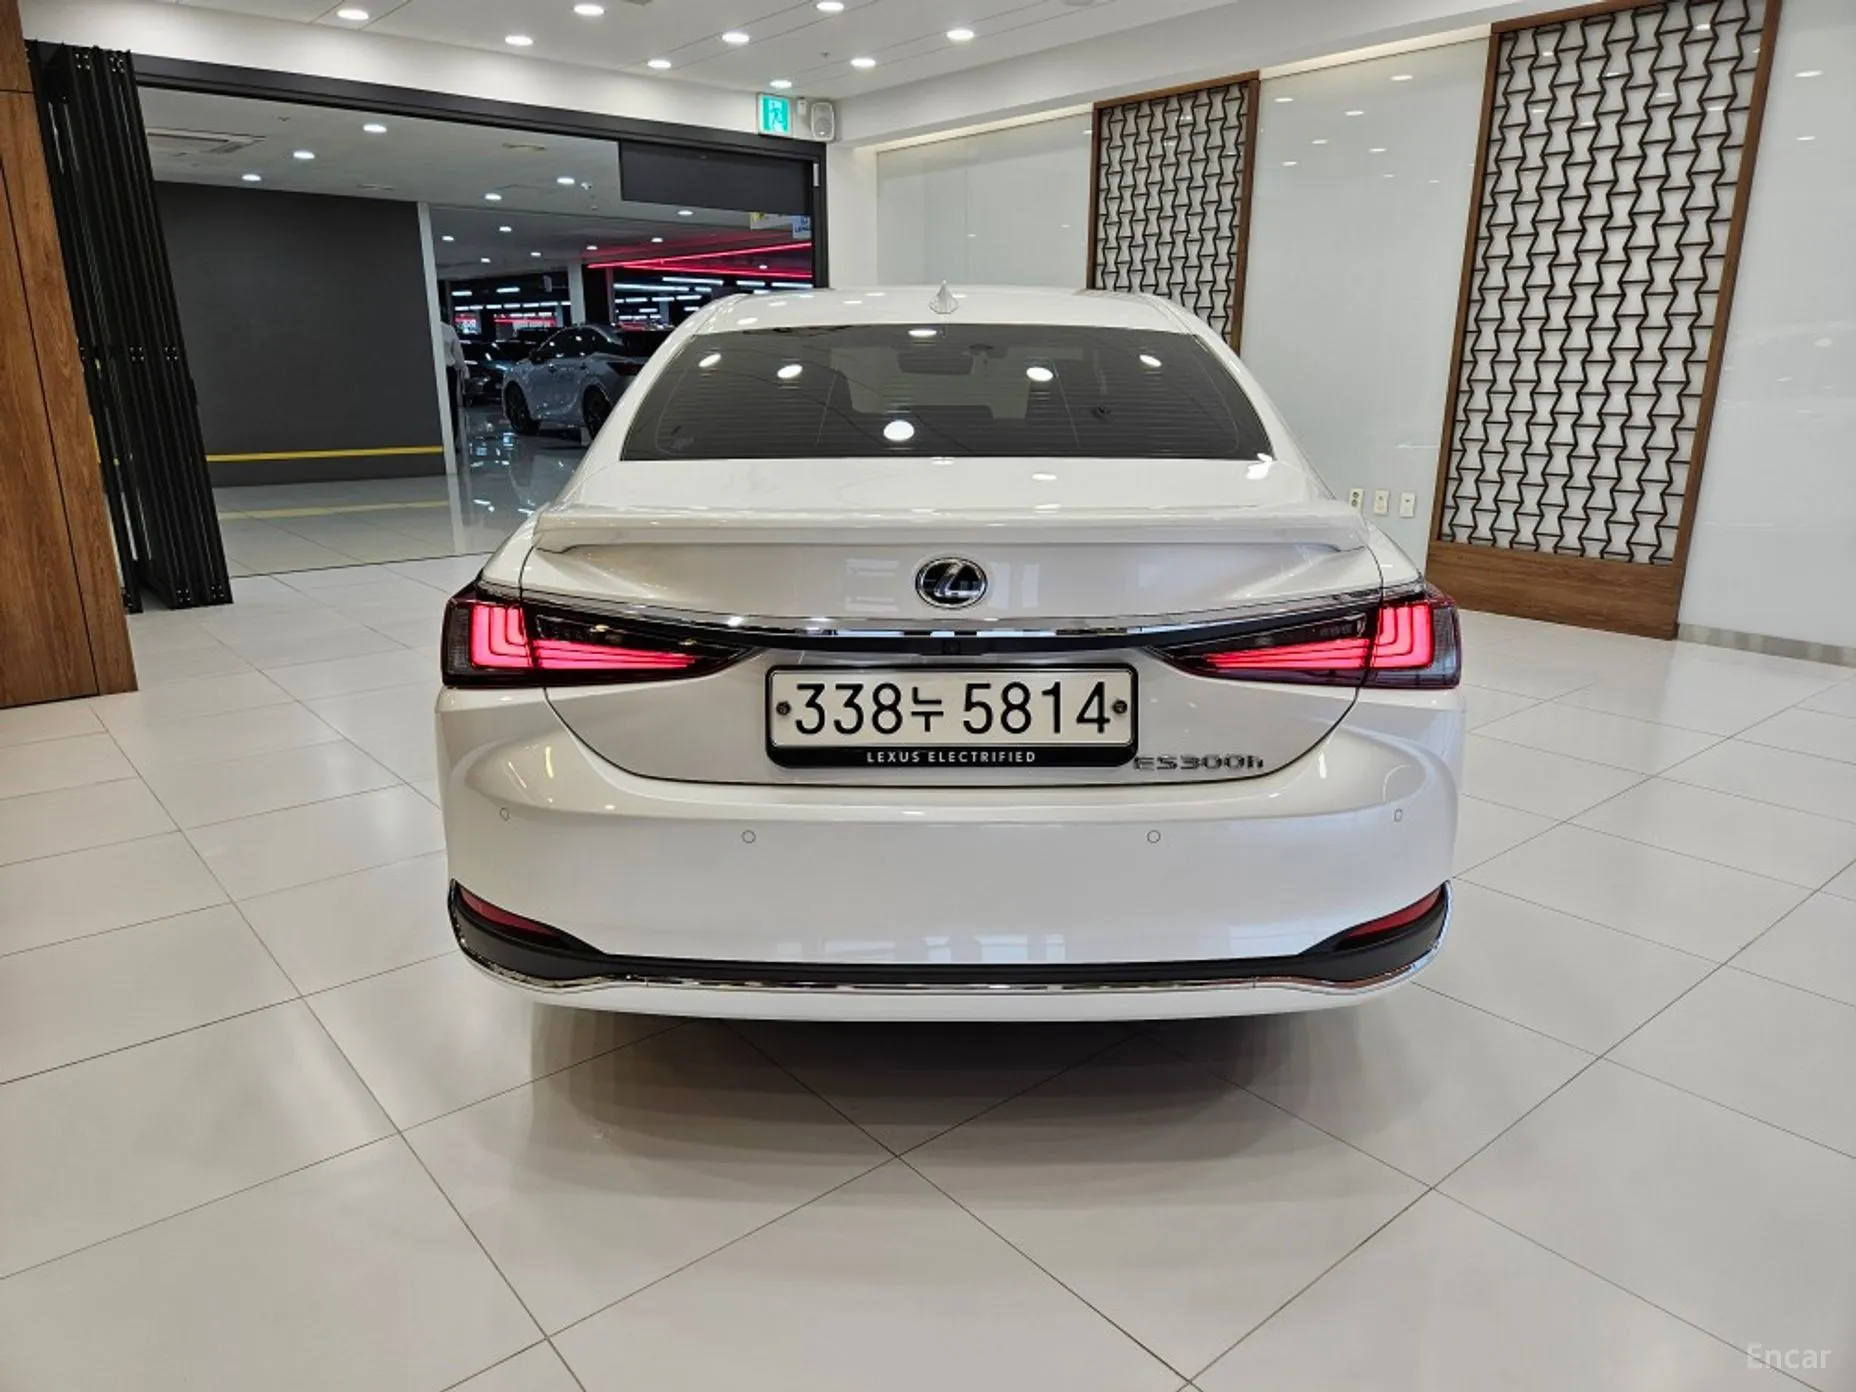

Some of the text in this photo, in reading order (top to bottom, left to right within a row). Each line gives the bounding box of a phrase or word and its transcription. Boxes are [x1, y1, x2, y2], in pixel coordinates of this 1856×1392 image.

[795, 681, 1110, 735] 338누 5814
[866, 751, 1036, 763] LEXUS ELECTRIFIED
[1132, 753, 1264, 771] ES300h
